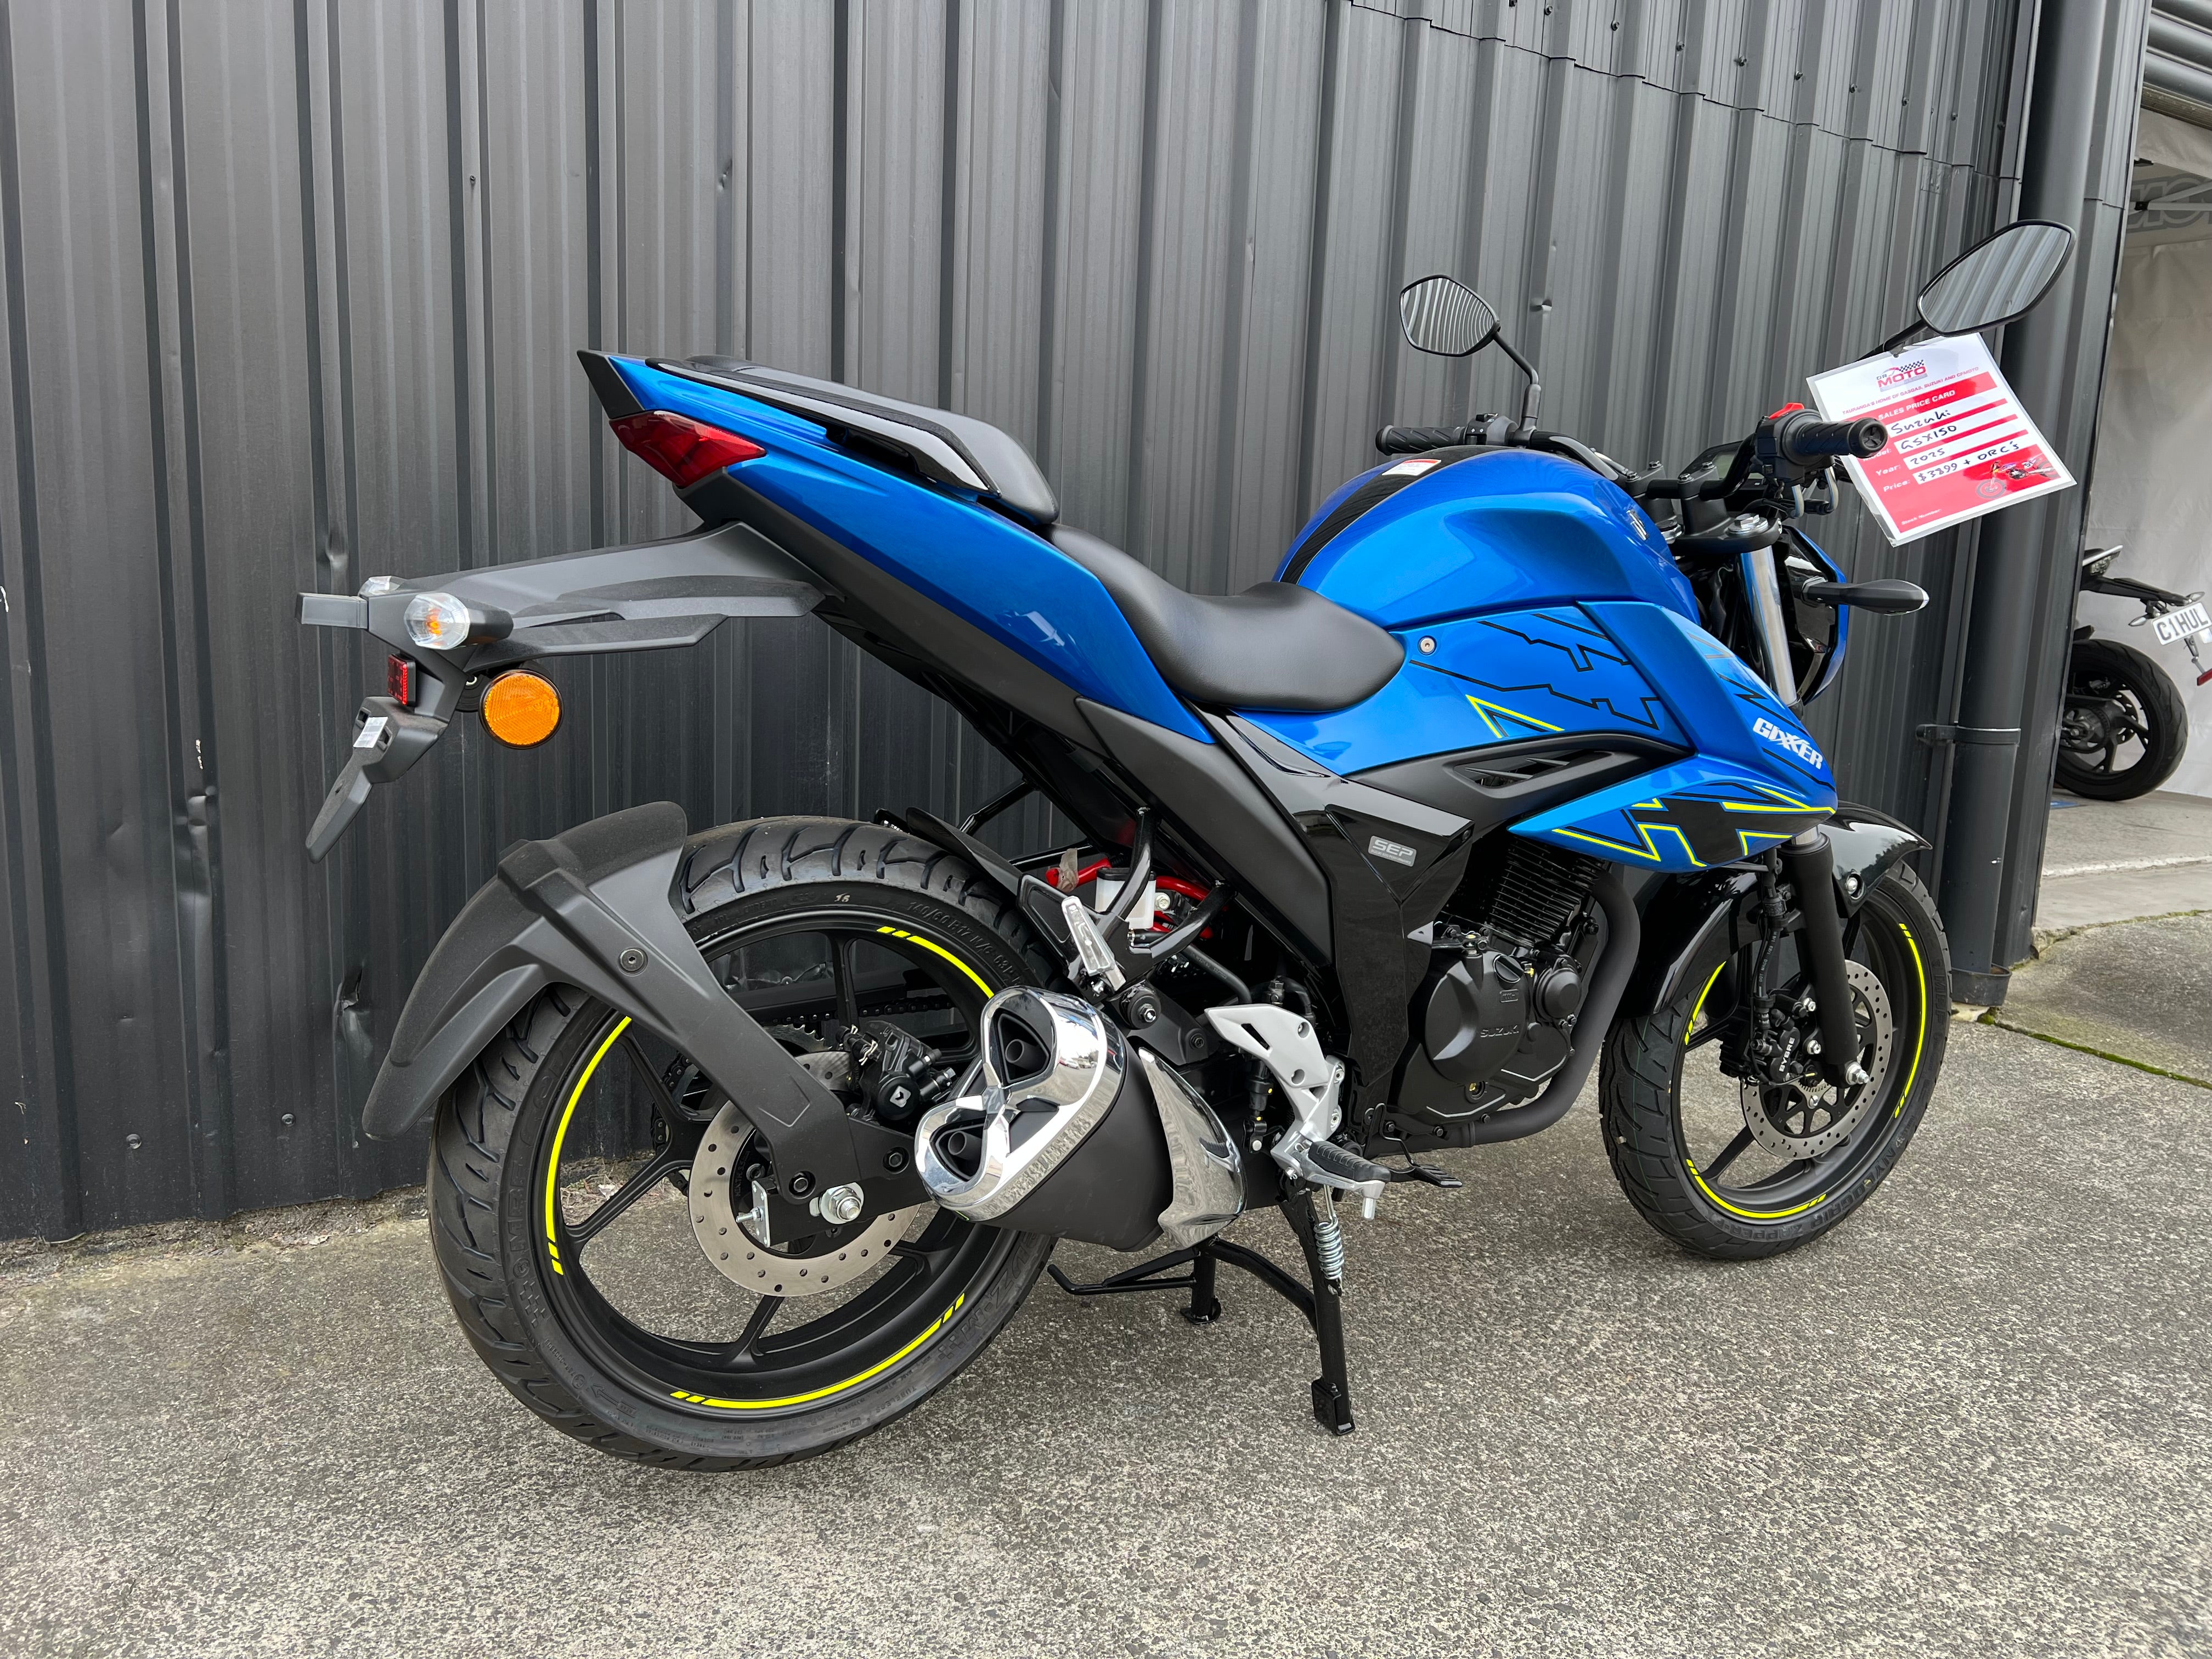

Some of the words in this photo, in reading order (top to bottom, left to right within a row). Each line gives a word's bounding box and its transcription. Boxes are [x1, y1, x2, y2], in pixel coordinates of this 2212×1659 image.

[1877, 366, 1926, 388] MOTO
[1876, 396, 1891, 404] HOME
[1924, 379, 1943, 388] SUZUKI
[1878, 407, 1905, 421] SALES
[1906, 398, 1931, 411] PRICE
[1932, 390, 1955, 402] CARD
[1901, 425, 1957, 449] GSX150
[1910, 448, 1945, 464] 2025
[1876, 465, 1901, 476] Year:
[1883, 479, 1910, 492] Price:
[1753, 717, 1824, 770] GIXXER
[1372, 839, 1413, 856] SEP
[1779, 1036, 1796, 1073] BYBRE
